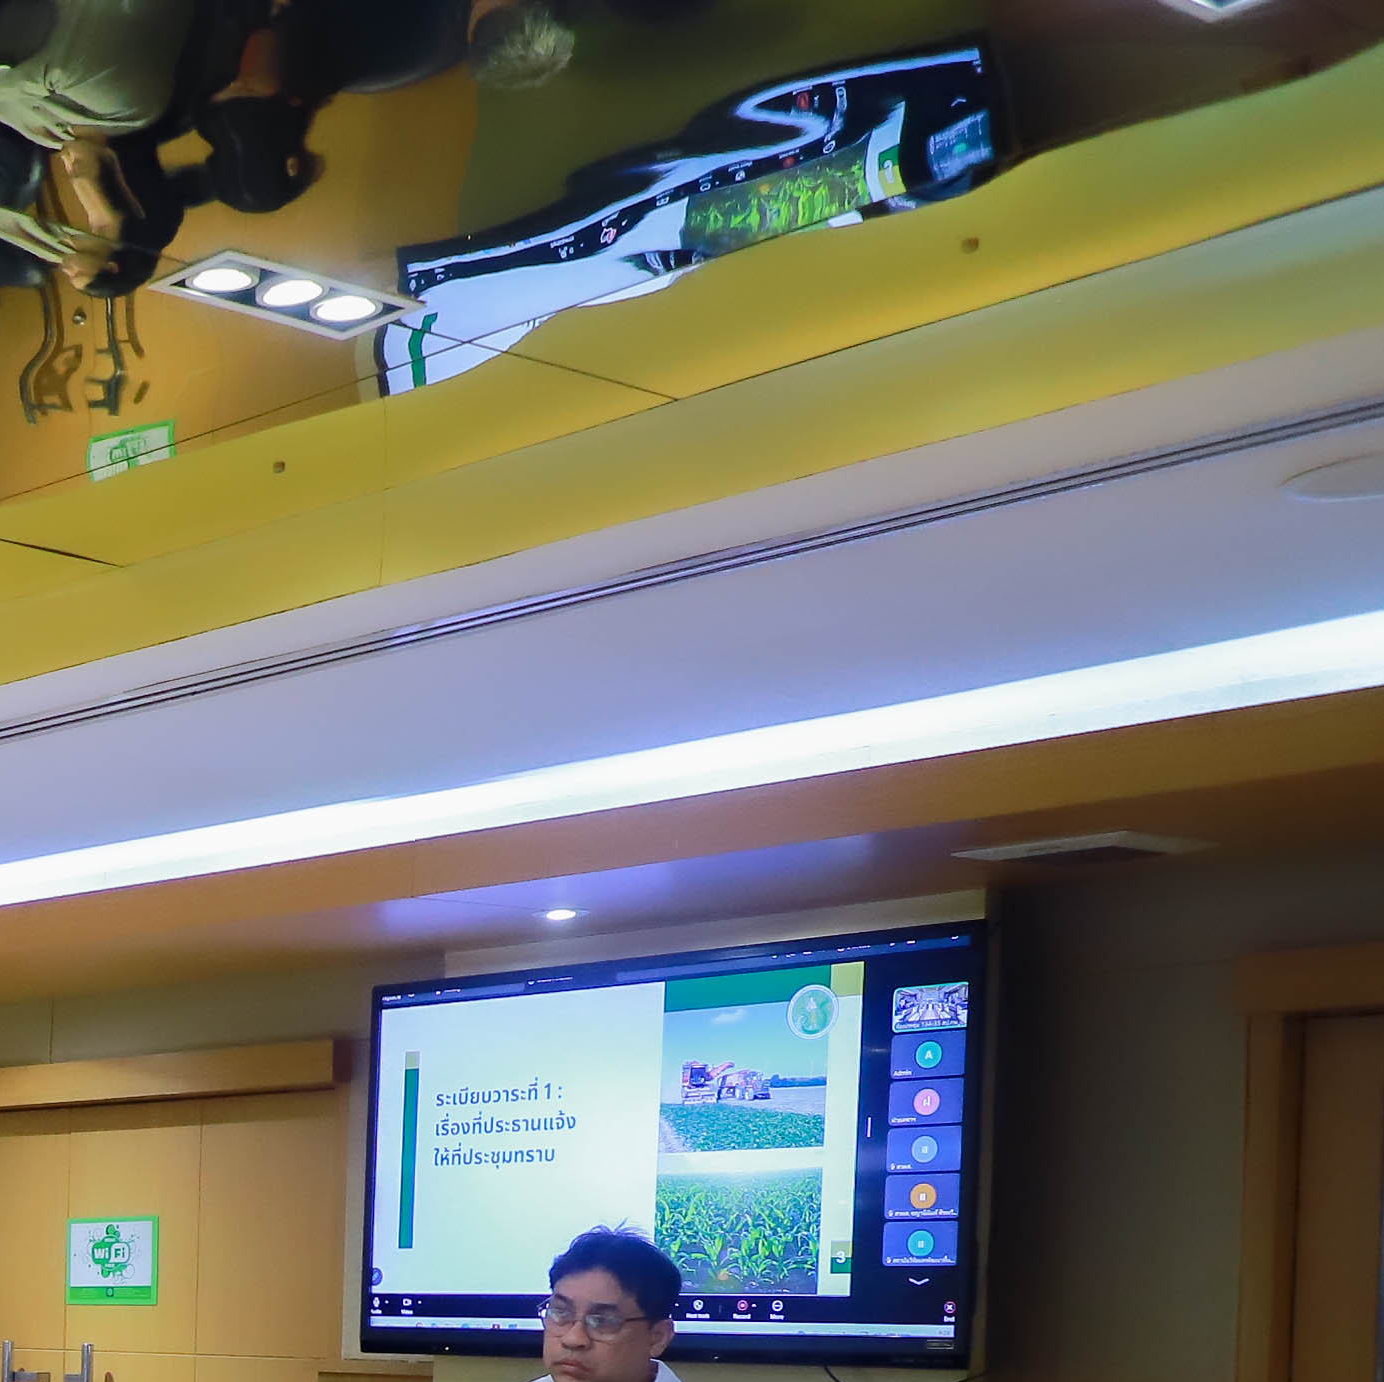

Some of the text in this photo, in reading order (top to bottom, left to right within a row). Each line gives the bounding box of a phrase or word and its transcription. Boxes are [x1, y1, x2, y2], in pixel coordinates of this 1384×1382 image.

[435, 1077, 538, 1107] ระเบียบวาระที่
[544, 1082, 552, 1100] 1
[435, 1109, 576, 1137] เรื่องที่ประธานแจ้ง
[434, 1142, 555, 1169] ให้ที่ประชุมทราบ
